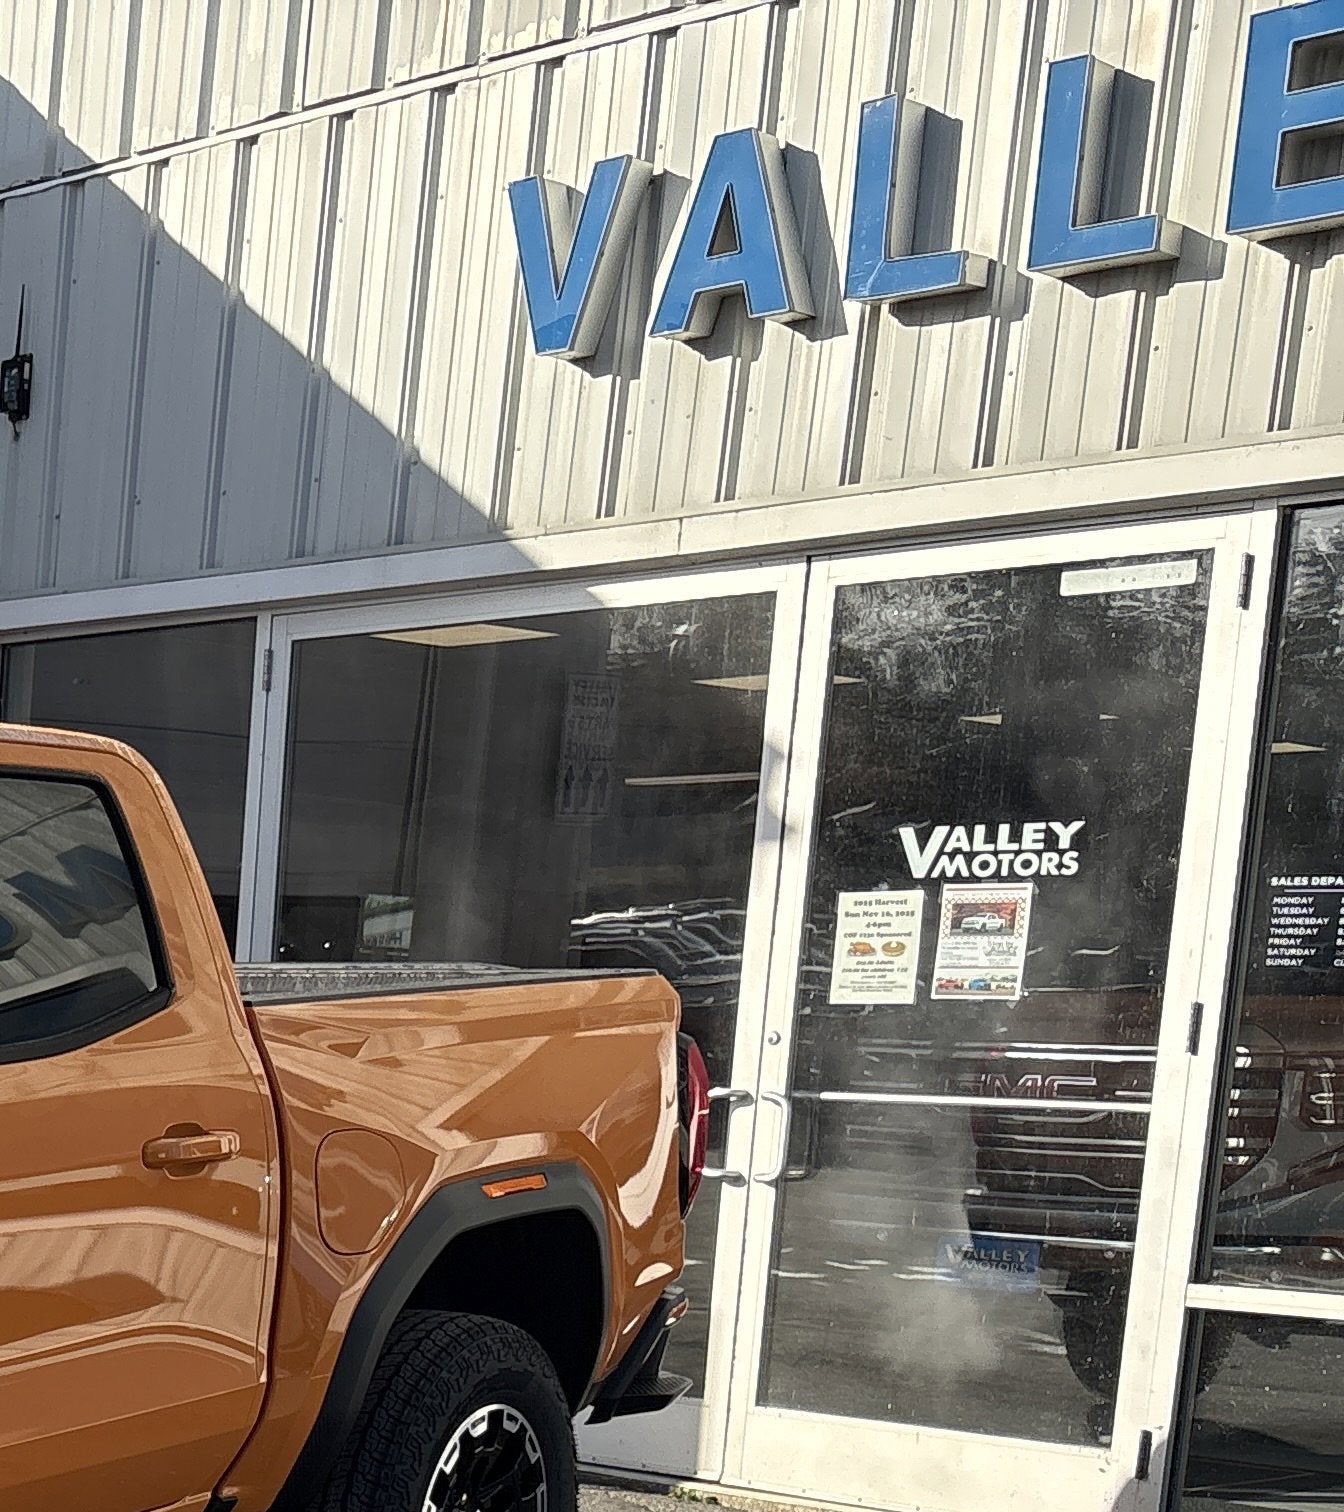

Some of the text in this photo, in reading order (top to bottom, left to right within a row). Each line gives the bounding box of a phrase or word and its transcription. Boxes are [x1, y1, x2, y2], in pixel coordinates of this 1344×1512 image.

[506, 0, 1344, 360] VALLE
[898, 820, 1086, 879] VALLEY
[930, 851, 1079, 878] MOTORS
[1270, 876, 1309, 887] SALES
[875, 898, 908, 906] Harvest
[1272, 896, 1315, 905] MONDAY
[1272, 906, 1315, 915] TUESDAY
[1270, 916, 1330, 926] WEDNESDAY
[1269, 927, 1320, 936] THURSDAY
[1267, 937, 1303, 946] FRIDAY
[1266, 947, 1317, 956] SATURDAY
[1265, 957, 1305, 967] SUNDAY
